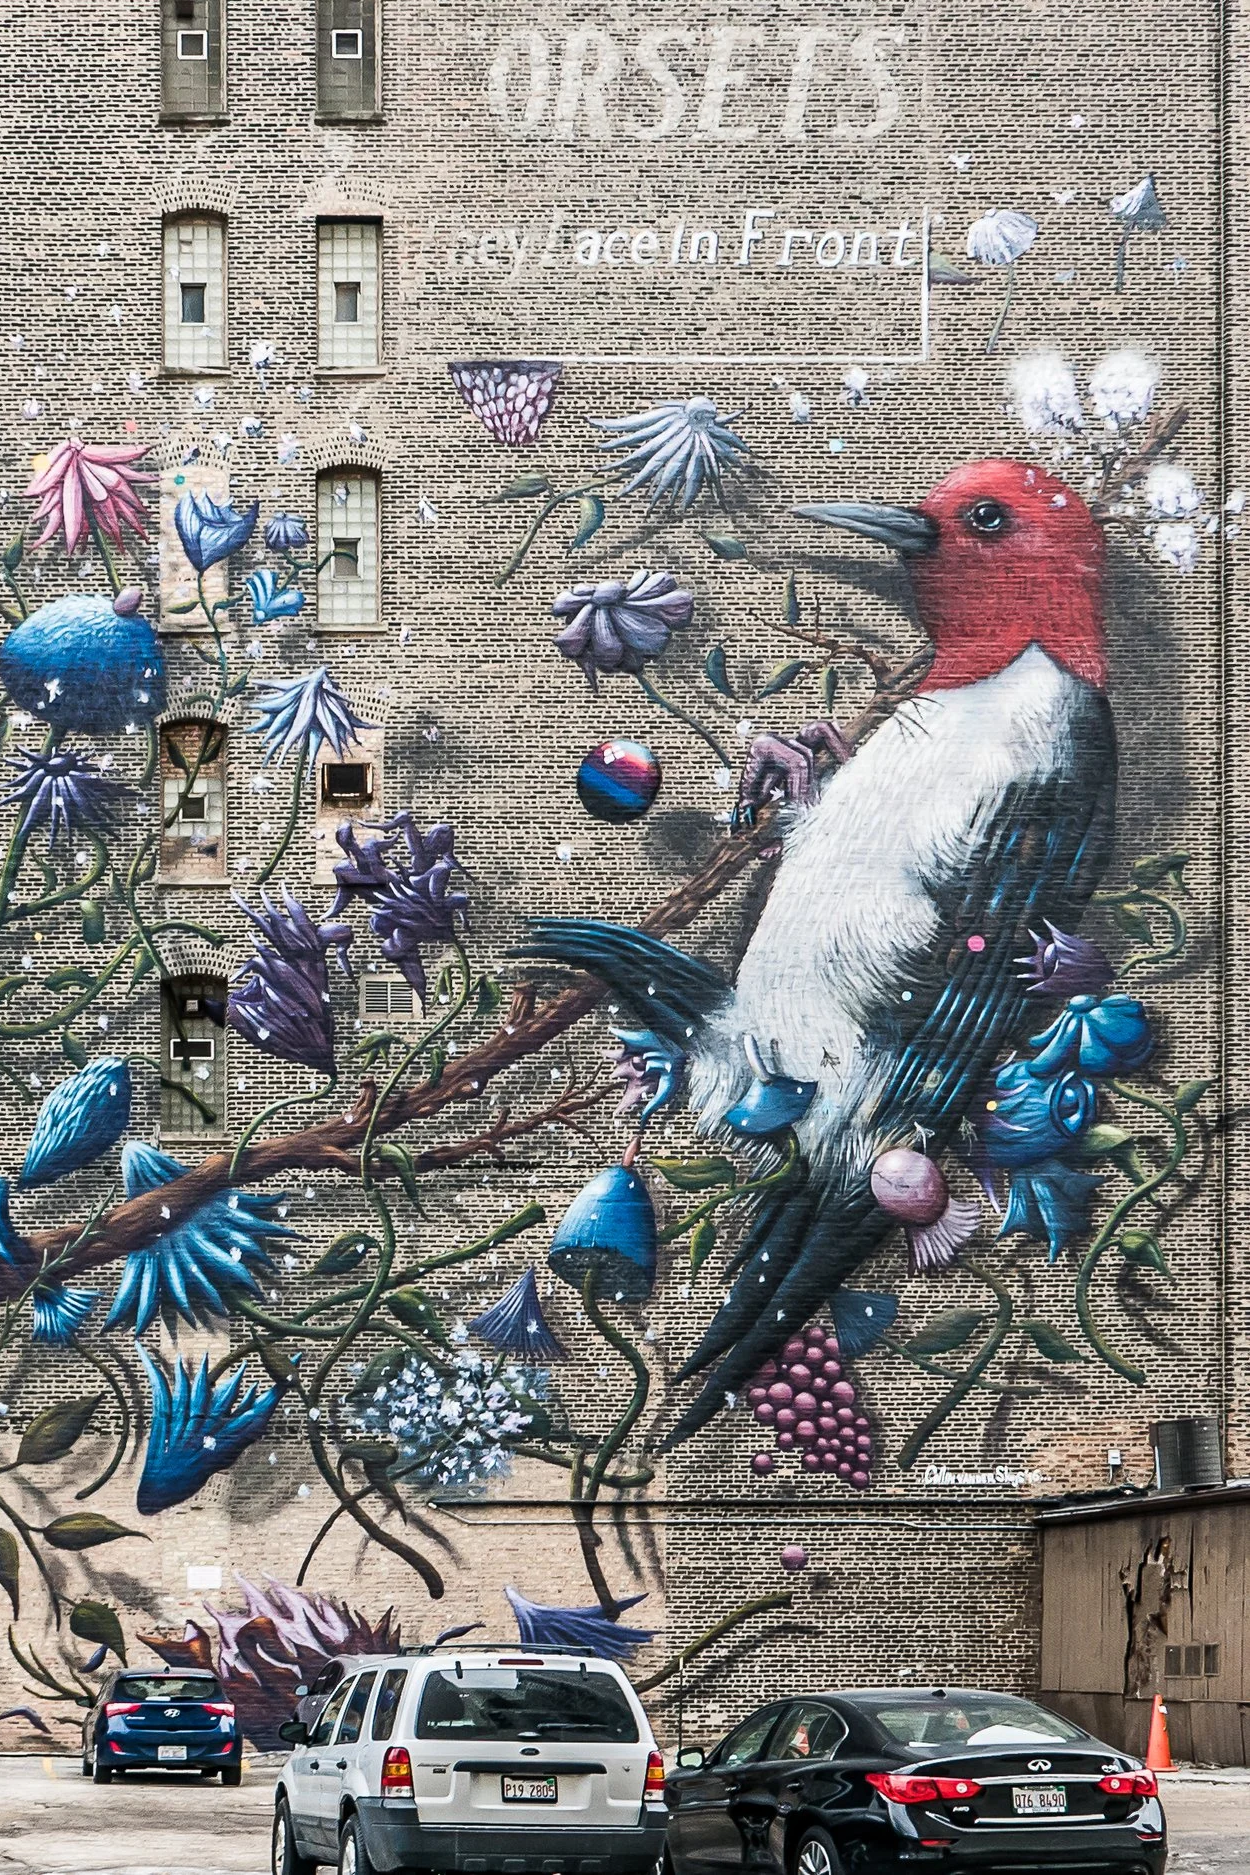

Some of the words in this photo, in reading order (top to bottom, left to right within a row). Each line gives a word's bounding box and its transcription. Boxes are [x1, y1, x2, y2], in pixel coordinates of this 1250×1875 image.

[735, 210, 917, 268] Front
[505, 1784, 524, 1798] P19
[529, 1784, 555, 1798] 2805
[1039, 1793, 1065, 1808] 8490
